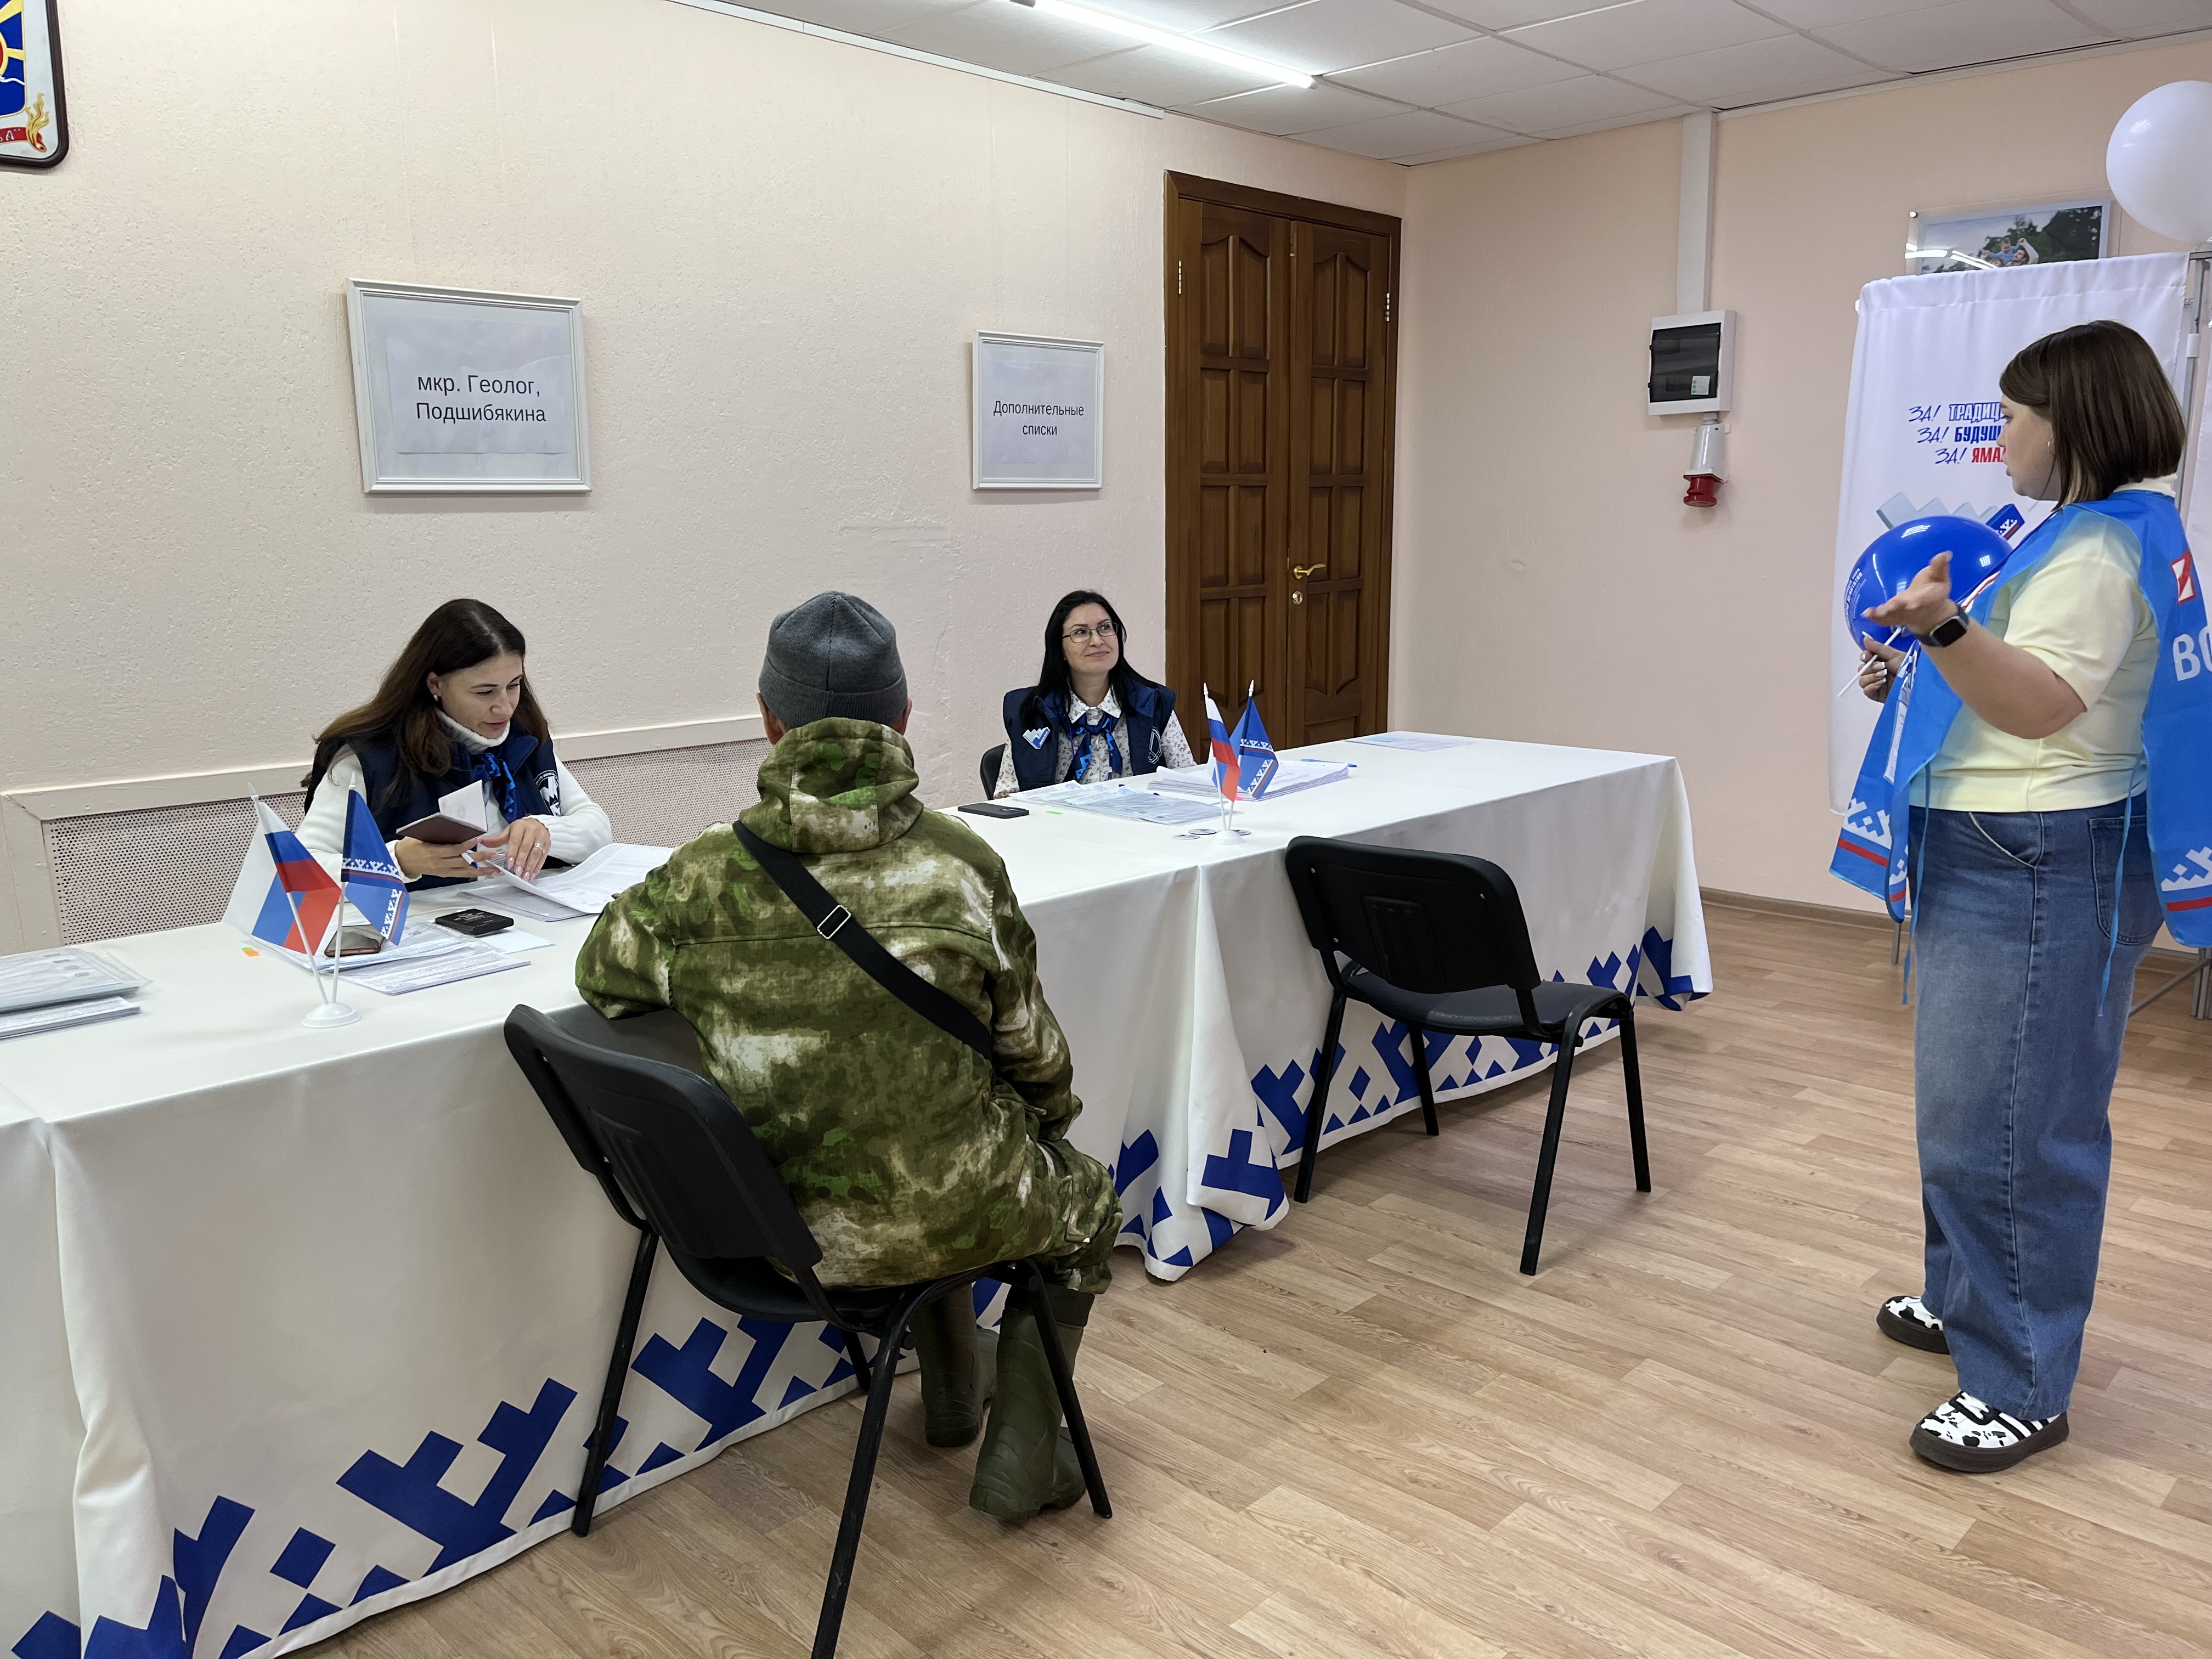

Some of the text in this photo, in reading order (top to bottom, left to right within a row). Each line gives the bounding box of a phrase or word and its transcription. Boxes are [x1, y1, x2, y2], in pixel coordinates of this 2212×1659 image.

[417, 375, 540, 398] мкр. Геолог,
[416, 402, 546, 424] Подшибякина
[993, 400, 1084, 417] Дополнительные
[1908, 402, 2001, 424] ЗА! ТРАДИЦ
[1022, 425, 1057, 436] списки
[1917, 426, 1950, 443] ЗА!
[1935, 447, 1968, 464] ЗА!
